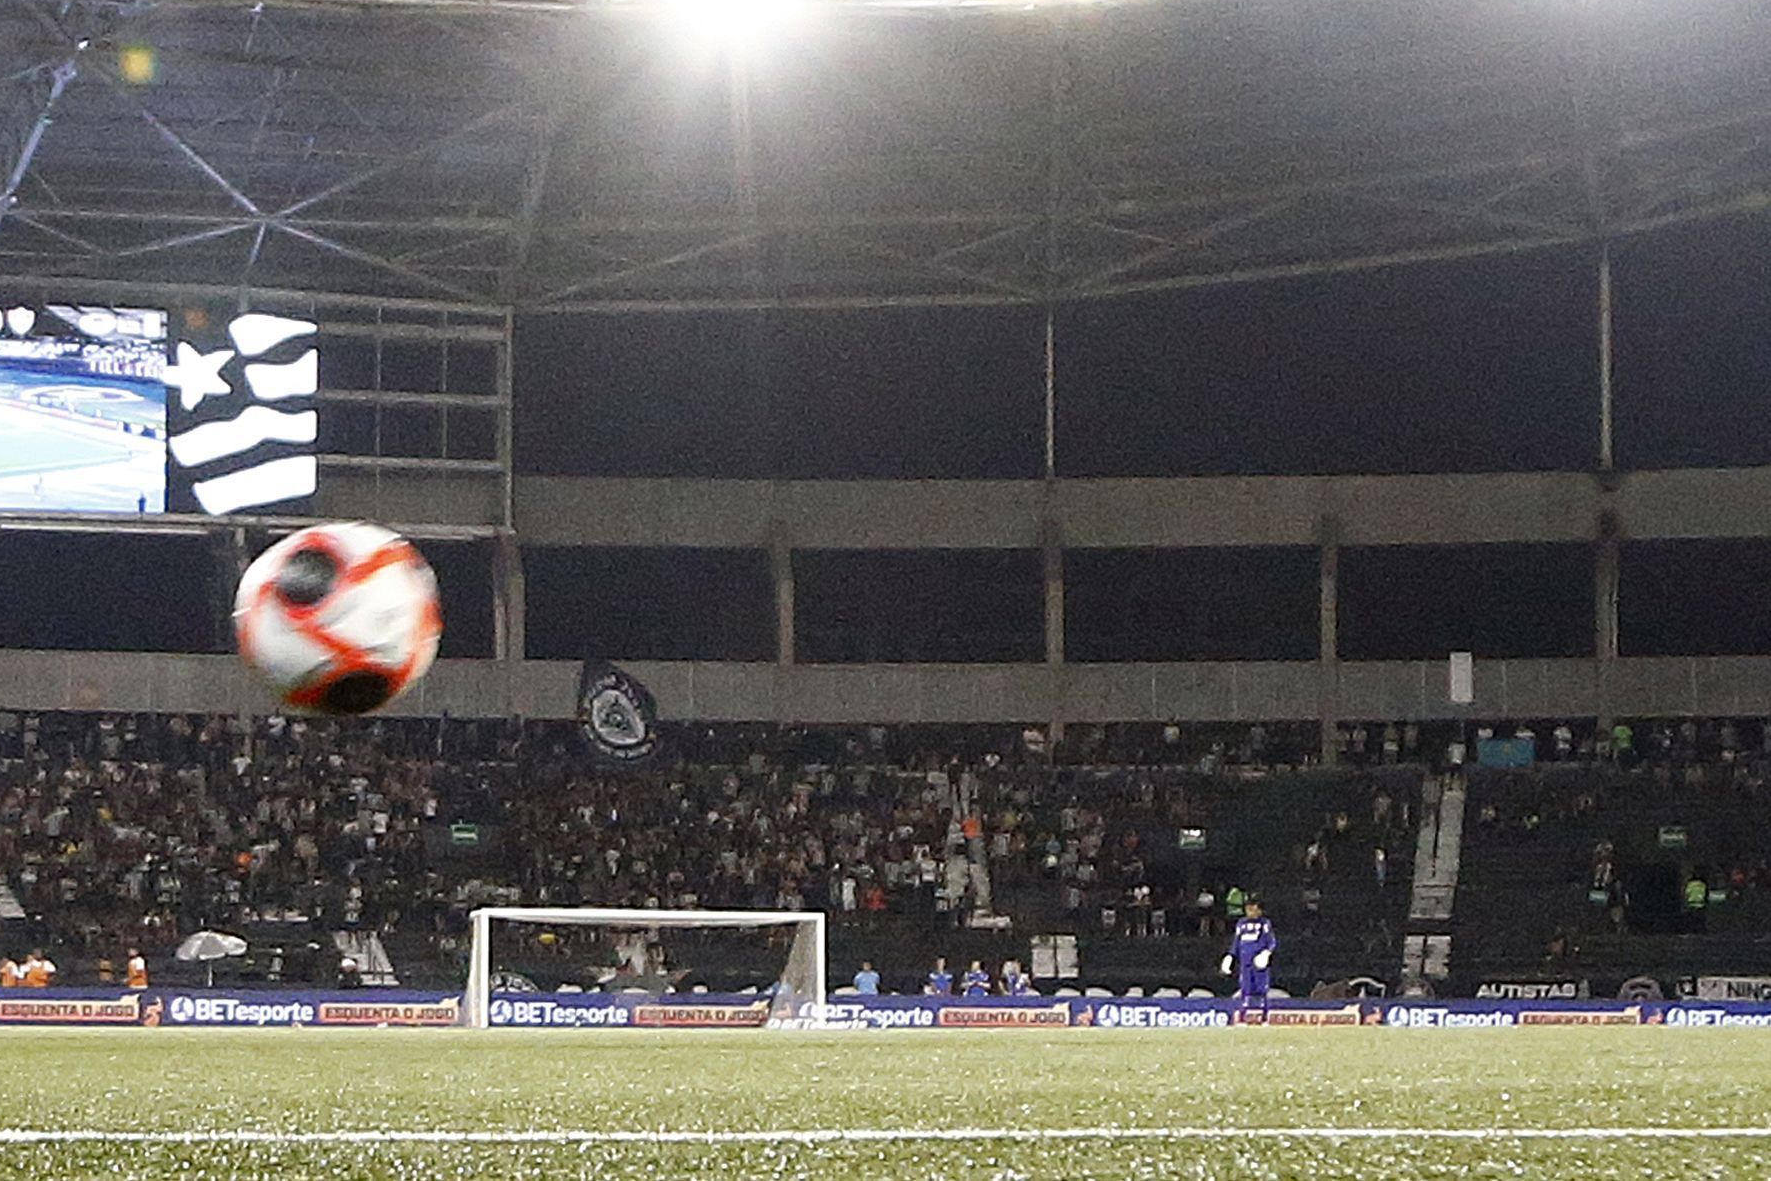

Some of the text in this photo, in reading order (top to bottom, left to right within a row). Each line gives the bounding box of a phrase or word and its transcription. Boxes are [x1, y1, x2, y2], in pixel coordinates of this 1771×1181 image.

[1477, 982, 1576, 998] AUTISTAS
[195, 999, 314, 1025] BETesporte
[512, 1001, 628, 1026] BETesporte
[1121, 1006, 1228, 1027] BETesporte
[1409, 1007, 1513, 1027] BETesporte
